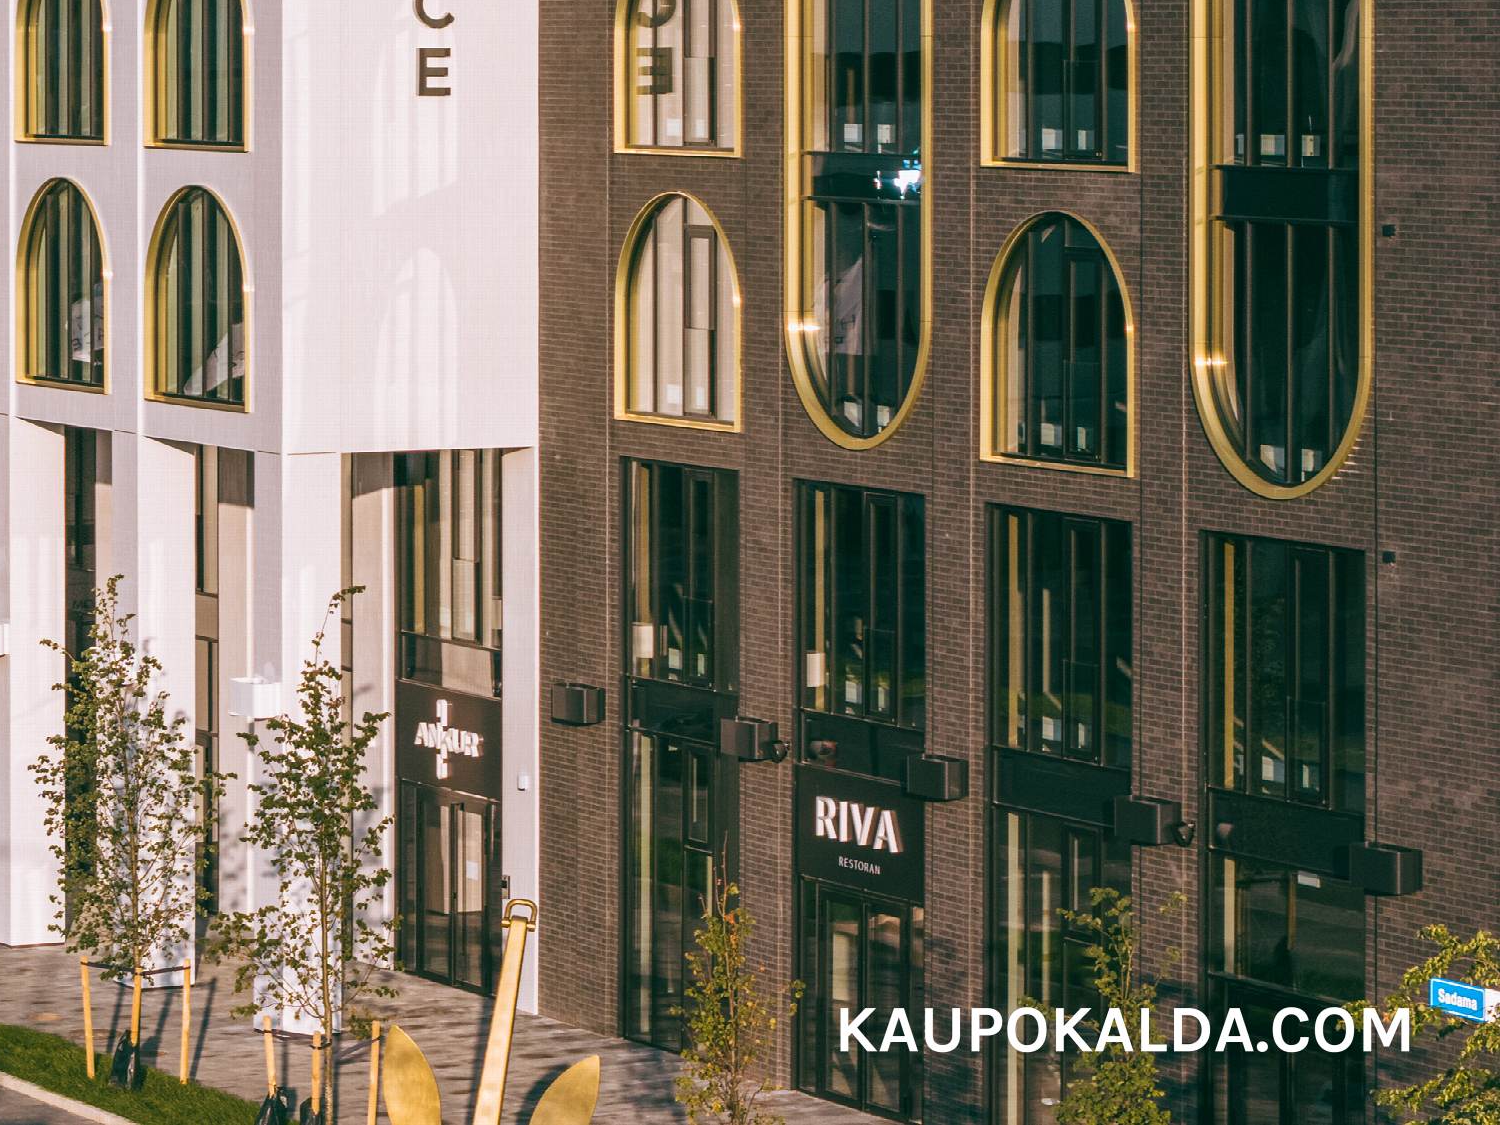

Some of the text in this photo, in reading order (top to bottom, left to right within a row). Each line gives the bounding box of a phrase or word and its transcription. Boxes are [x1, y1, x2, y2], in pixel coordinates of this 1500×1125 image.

[414, 722, 480, 757] ANKUR
[815, 795, 900, 853] RIVA
[838, 856, 881, 875] RESTORAN
[1437, 987, 1478, 1011] Sadama
